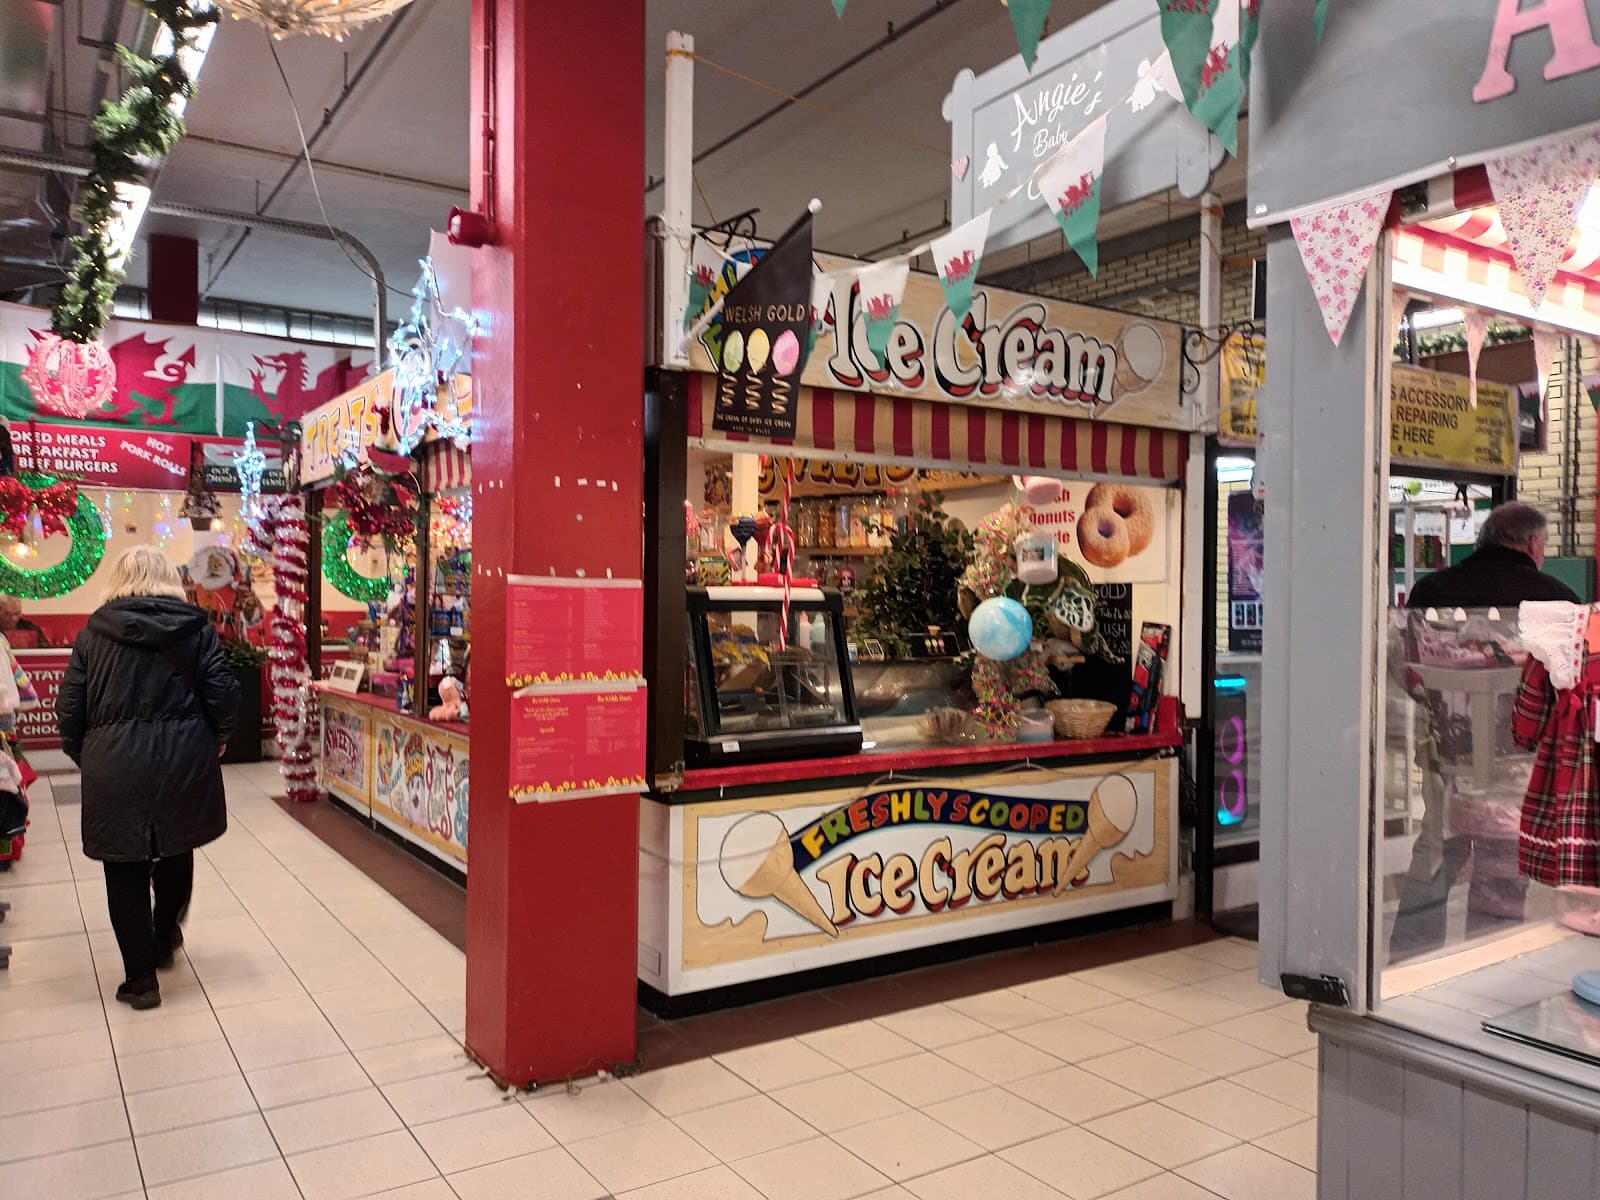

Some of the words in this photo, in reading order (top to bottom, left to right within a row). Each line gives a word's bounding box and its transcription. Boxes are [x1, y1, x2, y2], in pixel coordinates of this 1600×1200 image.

[1010, 70, 1103, 152] Angie's
[1032, 124, 1071, 156] Baby
[726, 305, 762, 323] WELSH
[767, 304, 805, 322] GOLD
[934, 291, 1117, 404] Cream
[1401, 386, 1470, 412] ACCESSORY
[1395, 407, 1458, 430] REPAIRING
[56, 433, 106, 447] MEALS
[1403, 426, 1435, 445] HERE
[55, 459, 118, 473] BURGERS
[120, 440, 152, 461] PORK
[152, 455, 187, 477] ROLLS
[801, 790, 949, 859] FRESHLY
[950, 791, 1085, 831] SCOOPED
